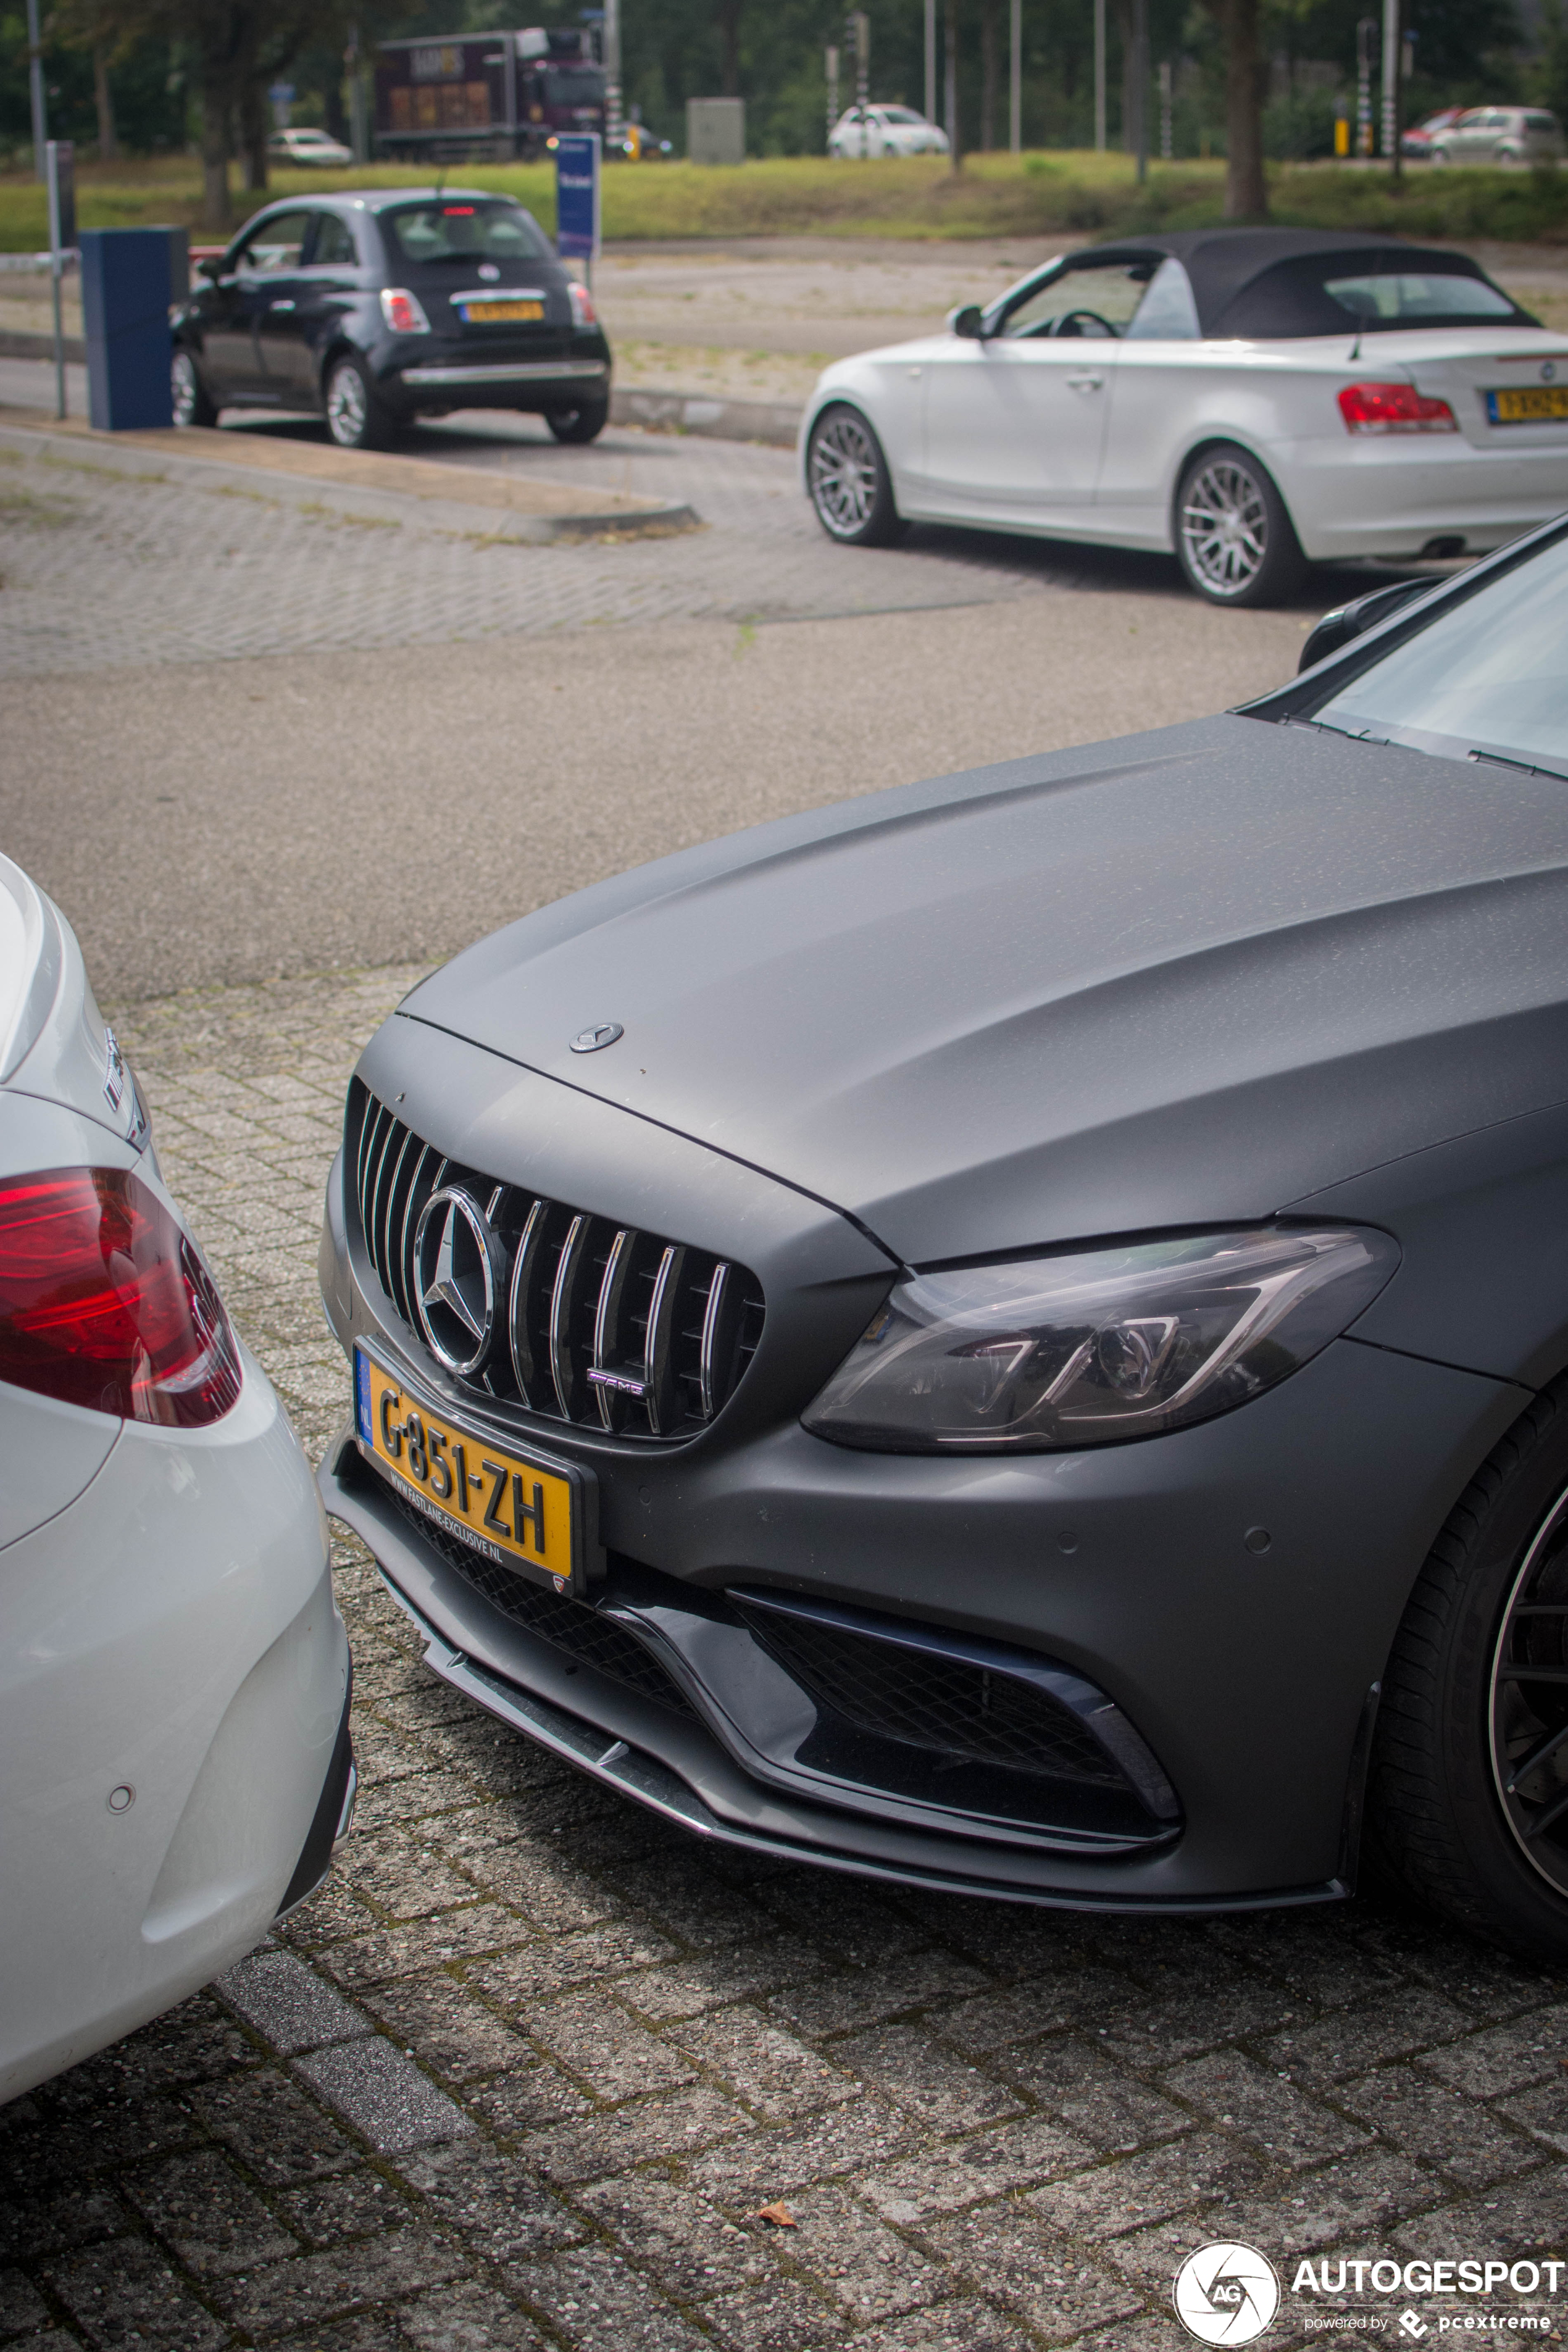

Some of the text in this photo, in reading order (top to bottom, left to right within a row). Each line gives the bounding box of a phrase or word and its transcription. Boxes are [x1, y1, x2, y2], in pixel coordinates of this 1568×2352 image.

[604, 1378, 643, 1396] AMG
[361, 1404, 371, 1430] NL
[380, 1388, 545, 1554] G-851-ZH
